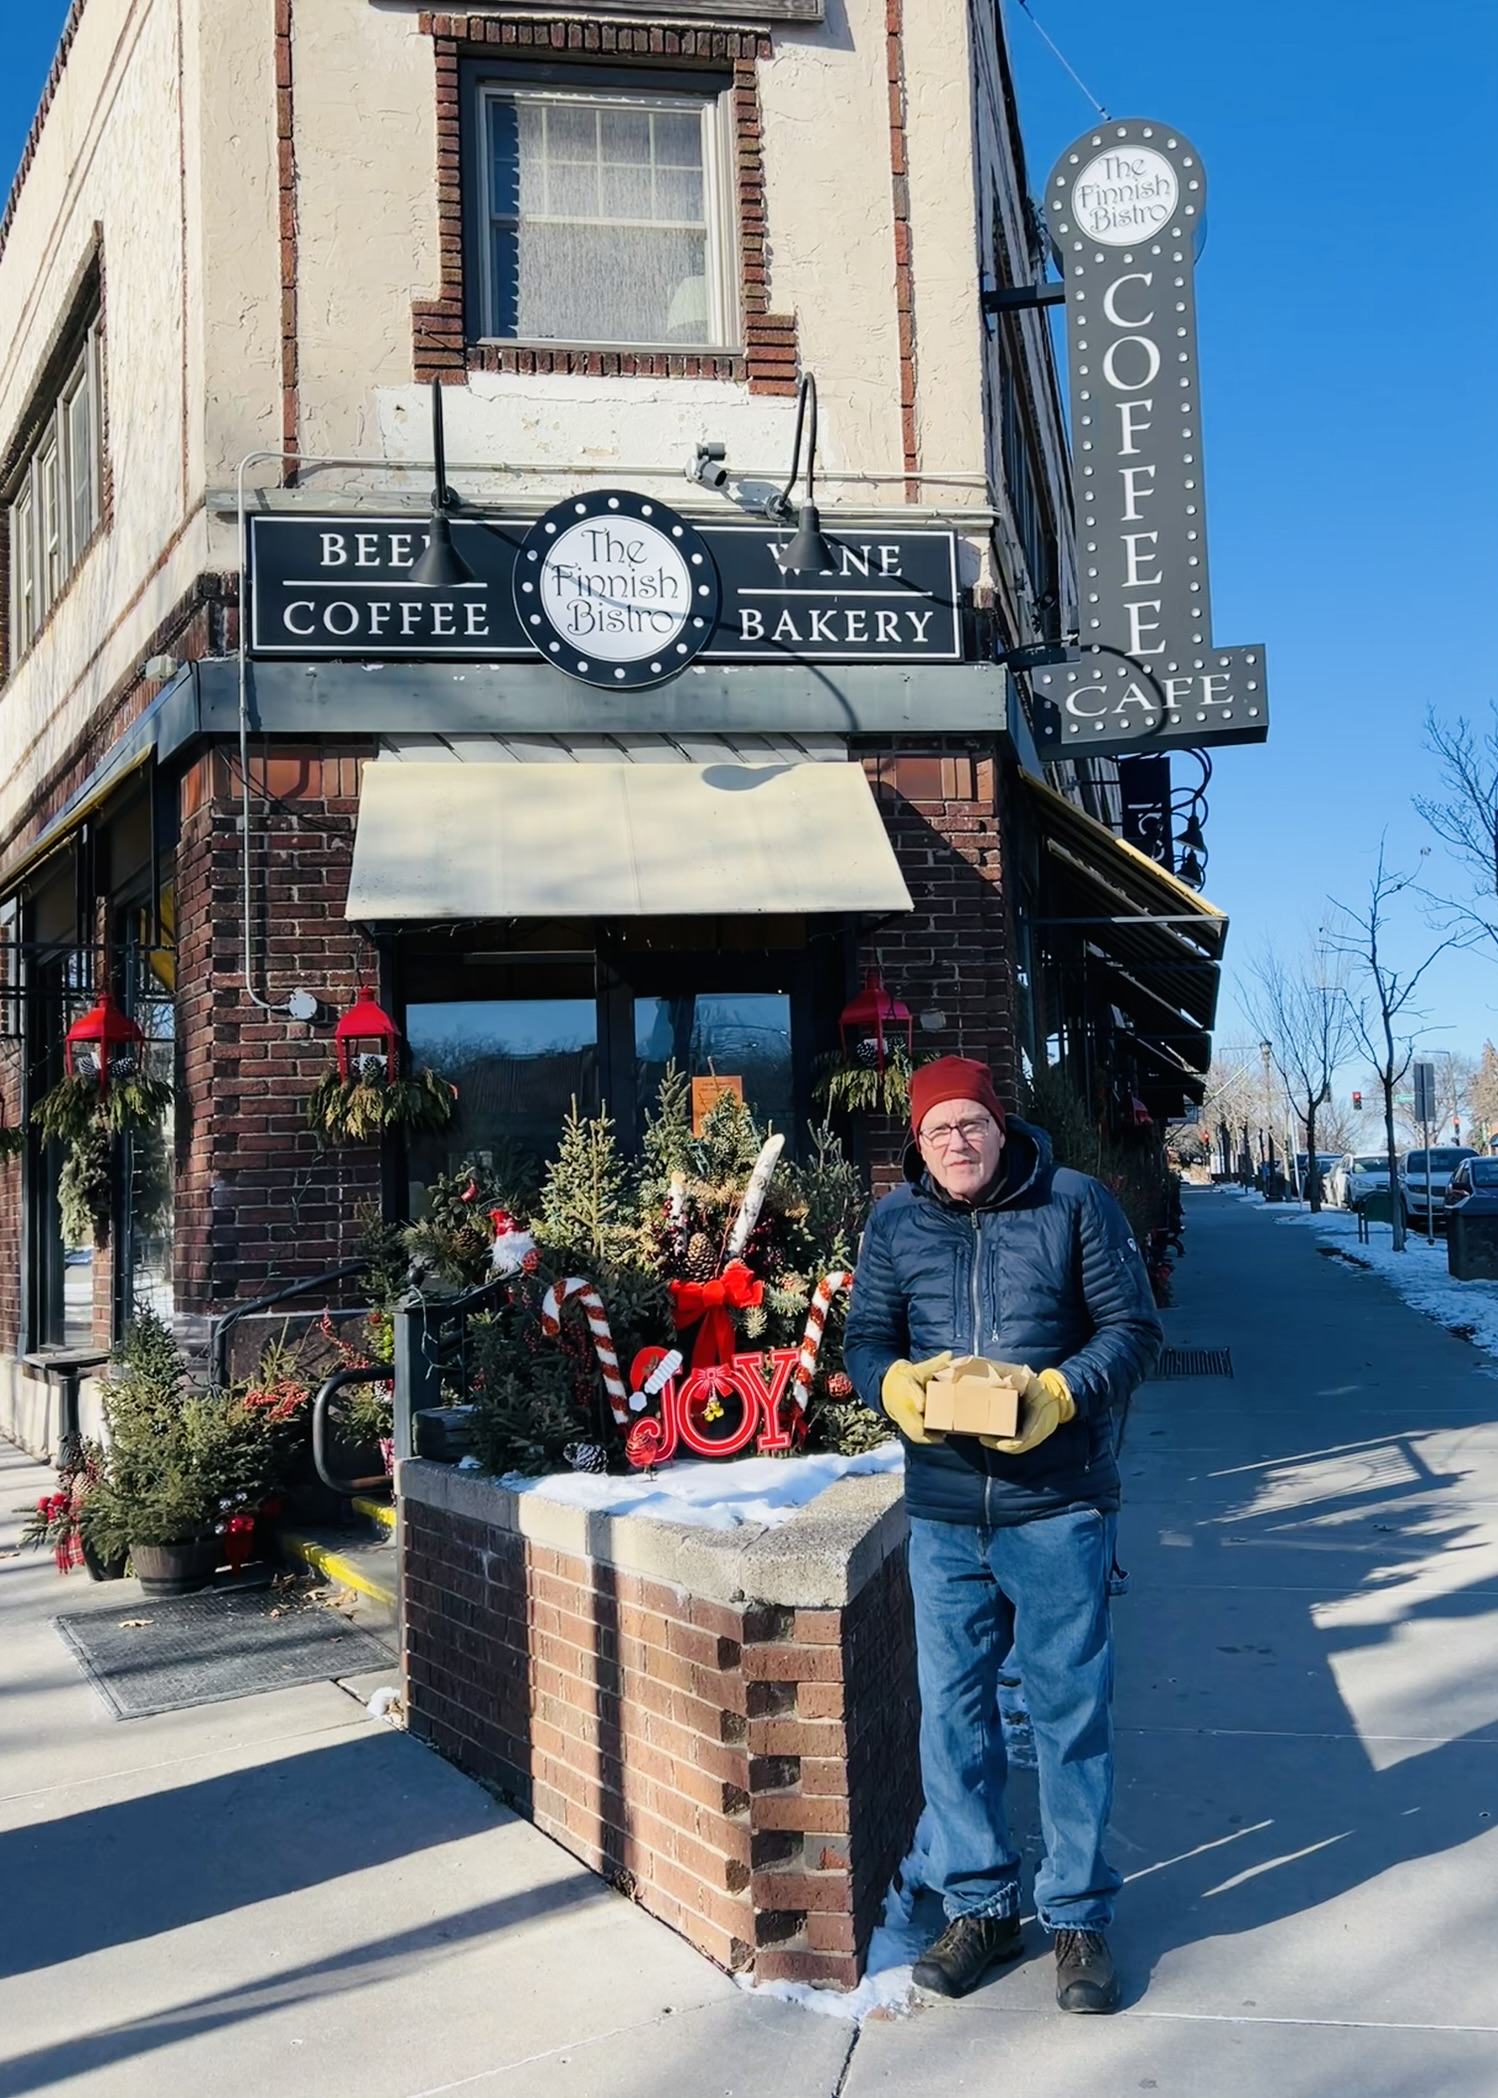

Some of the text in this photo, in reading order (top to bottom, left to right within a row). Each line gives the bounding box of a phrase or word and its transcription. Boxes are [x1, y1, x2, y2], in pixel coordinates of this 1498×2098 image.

[1099, 155, 1147, 180] The
[1078, 174, 1170, 208] Finnish
[1090, 204, 1168, 233] Bistro
[1103, 271, 1167, 657] COFFEE
[319, 533, 431, 567] BEE
[581, 528, 648, 567] The
[766, 543, 903, 577] NE
[551, 562, 678, 599] Finnish
[283, 601, 489, 635] COFFEE
[566, 599, 675, 636] Bistro
[738, 608, 934, 642] BAKERY
[1065, 673, 1235, 717] CAFE
[630, 1348, 800, 1463] JOY
